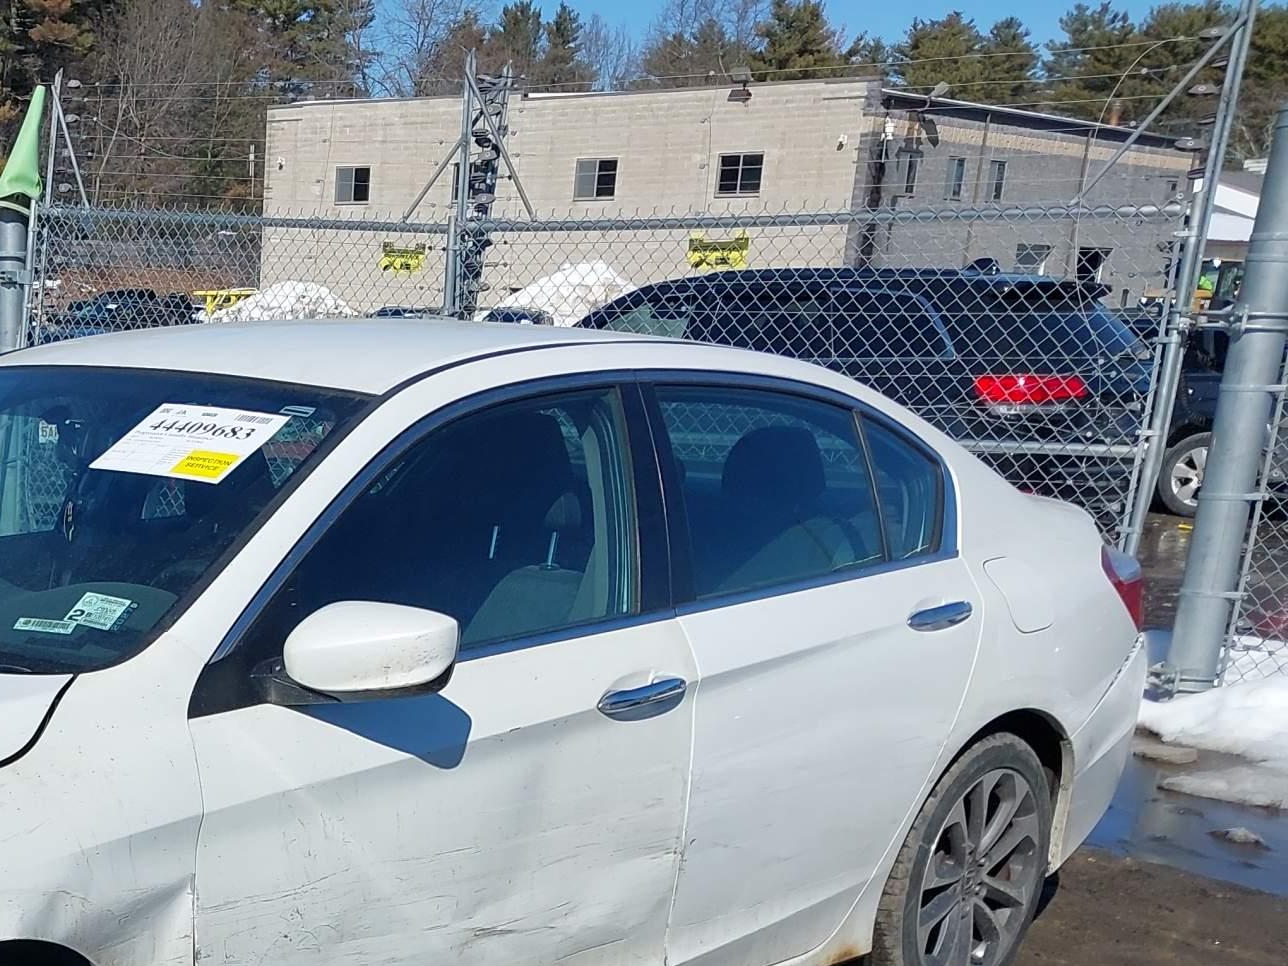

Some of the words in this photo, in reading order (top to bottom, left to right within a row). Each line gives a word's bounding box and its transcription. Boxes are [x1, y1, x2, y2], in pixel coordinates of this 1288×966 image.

[150, 419, 257, 441] 44409683
[186, 455, 233, 466] INSPECTION
[67, 609, 86, 621] 2
